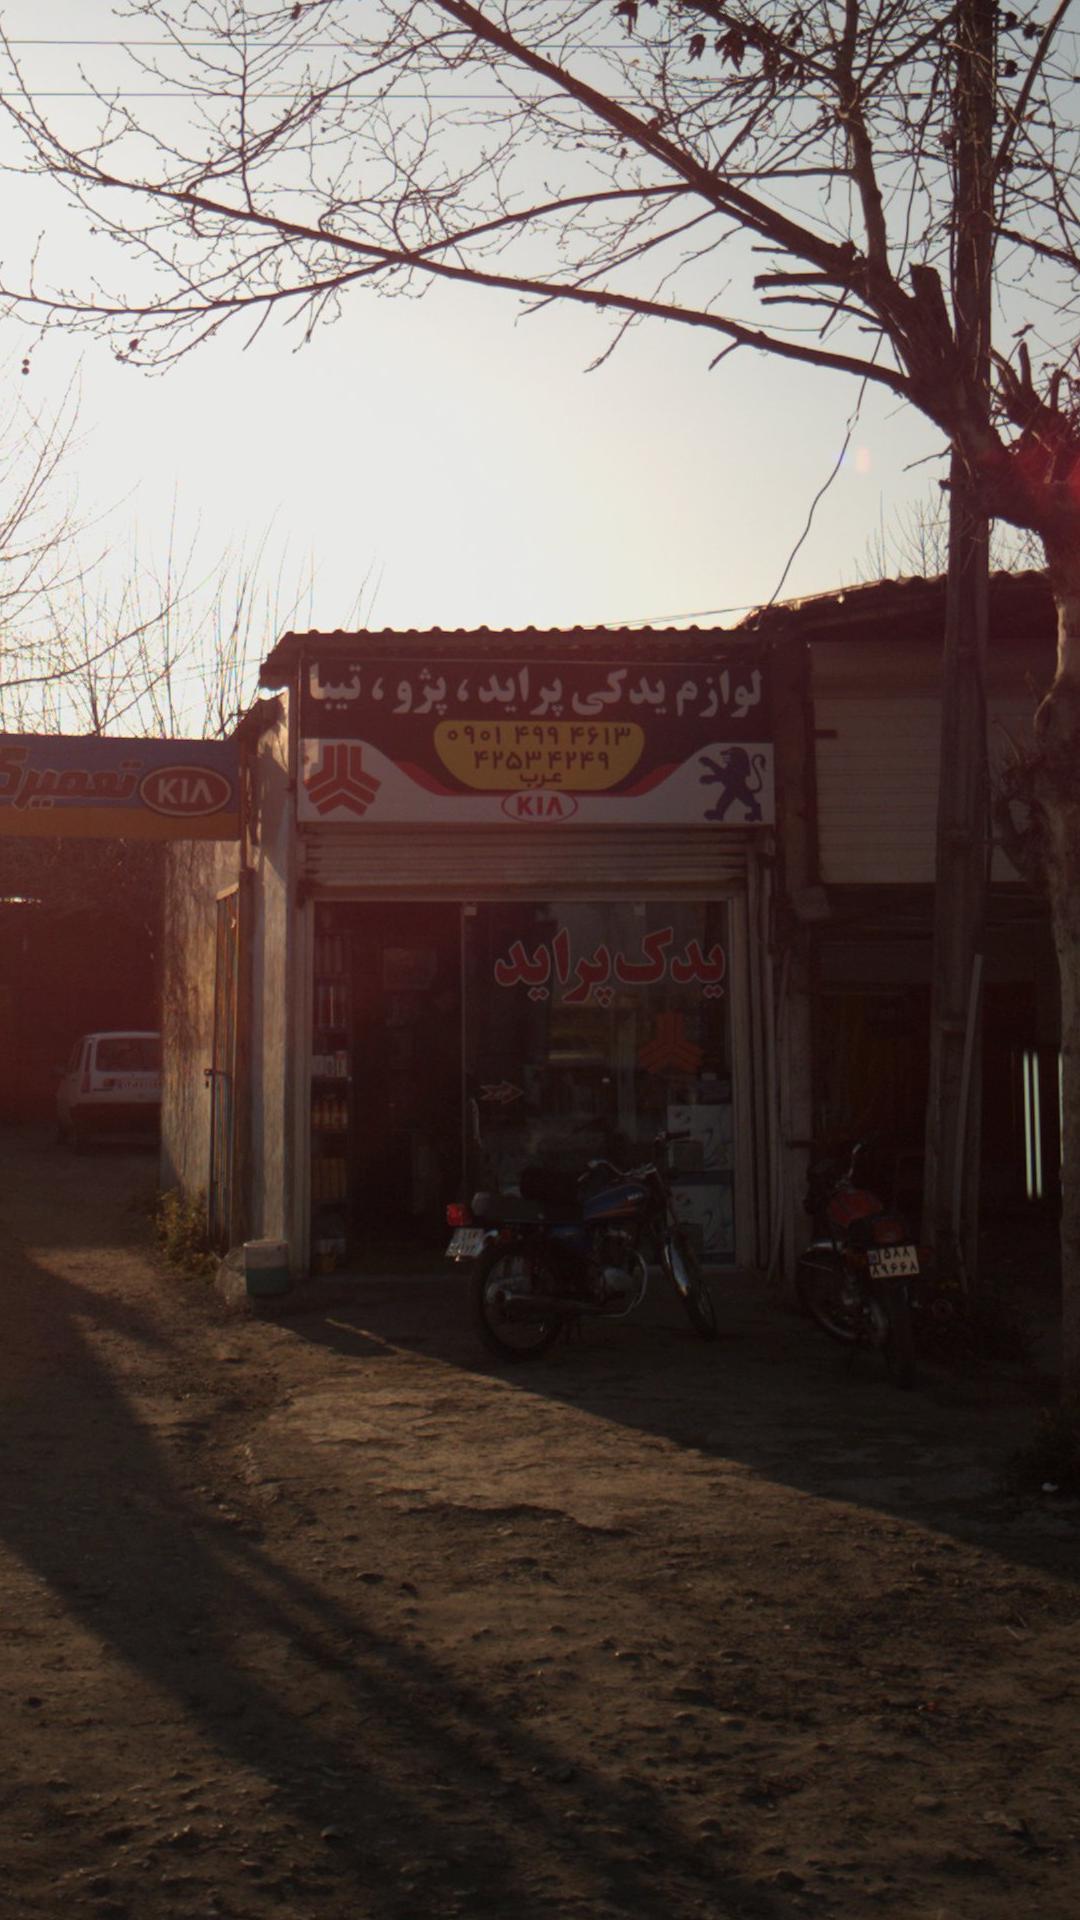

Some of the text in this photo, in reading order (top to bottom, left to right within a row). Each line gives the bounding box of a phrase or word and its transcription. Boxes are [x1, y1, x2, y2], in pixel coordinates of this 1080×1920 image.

[309, 661, 361, 710] تیبا
[572, 668, 666, 716] یدکی
[676, 668, 763, 718] لوازم
[515, 726, 559, 745] ۴۹۹
[569, 726, 630, 746] ۴۶۱۳
[157, 777, 213, 805] KIA
[519, 772, 563, 788] عرب
[516, 796, 564, 816] KIA
